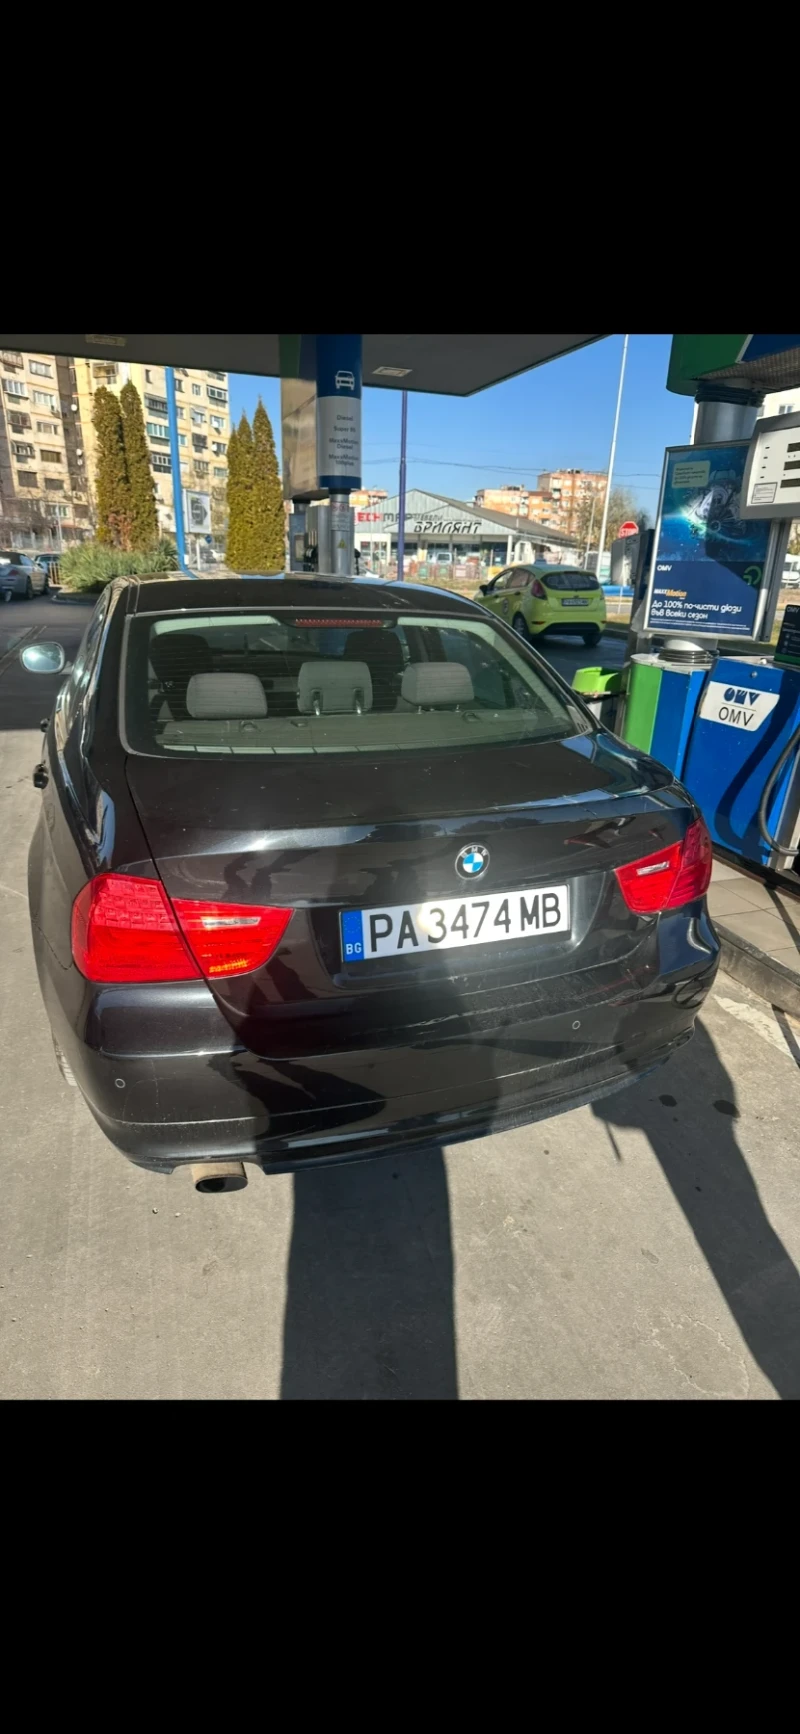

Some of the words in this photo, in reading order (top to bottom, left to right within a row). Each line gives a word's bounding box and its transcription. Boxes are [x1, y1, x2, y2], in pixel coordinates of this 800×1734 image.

[414, 521, 482, 534] БРИЛЯНТ
[651, 600, 662, 608] До
[664, 600, 683, 609] 100%
[683, 603, 720, 611] по-чисти
[687, 611, 708, 620] сезон
[718, 706, 754, 727] OMV
[369, 910, 420, 953] PA
[427, 898, 512, 944] 3474
[519, 892, 562, 932] MB
[345, 942, 363, 955] BG
